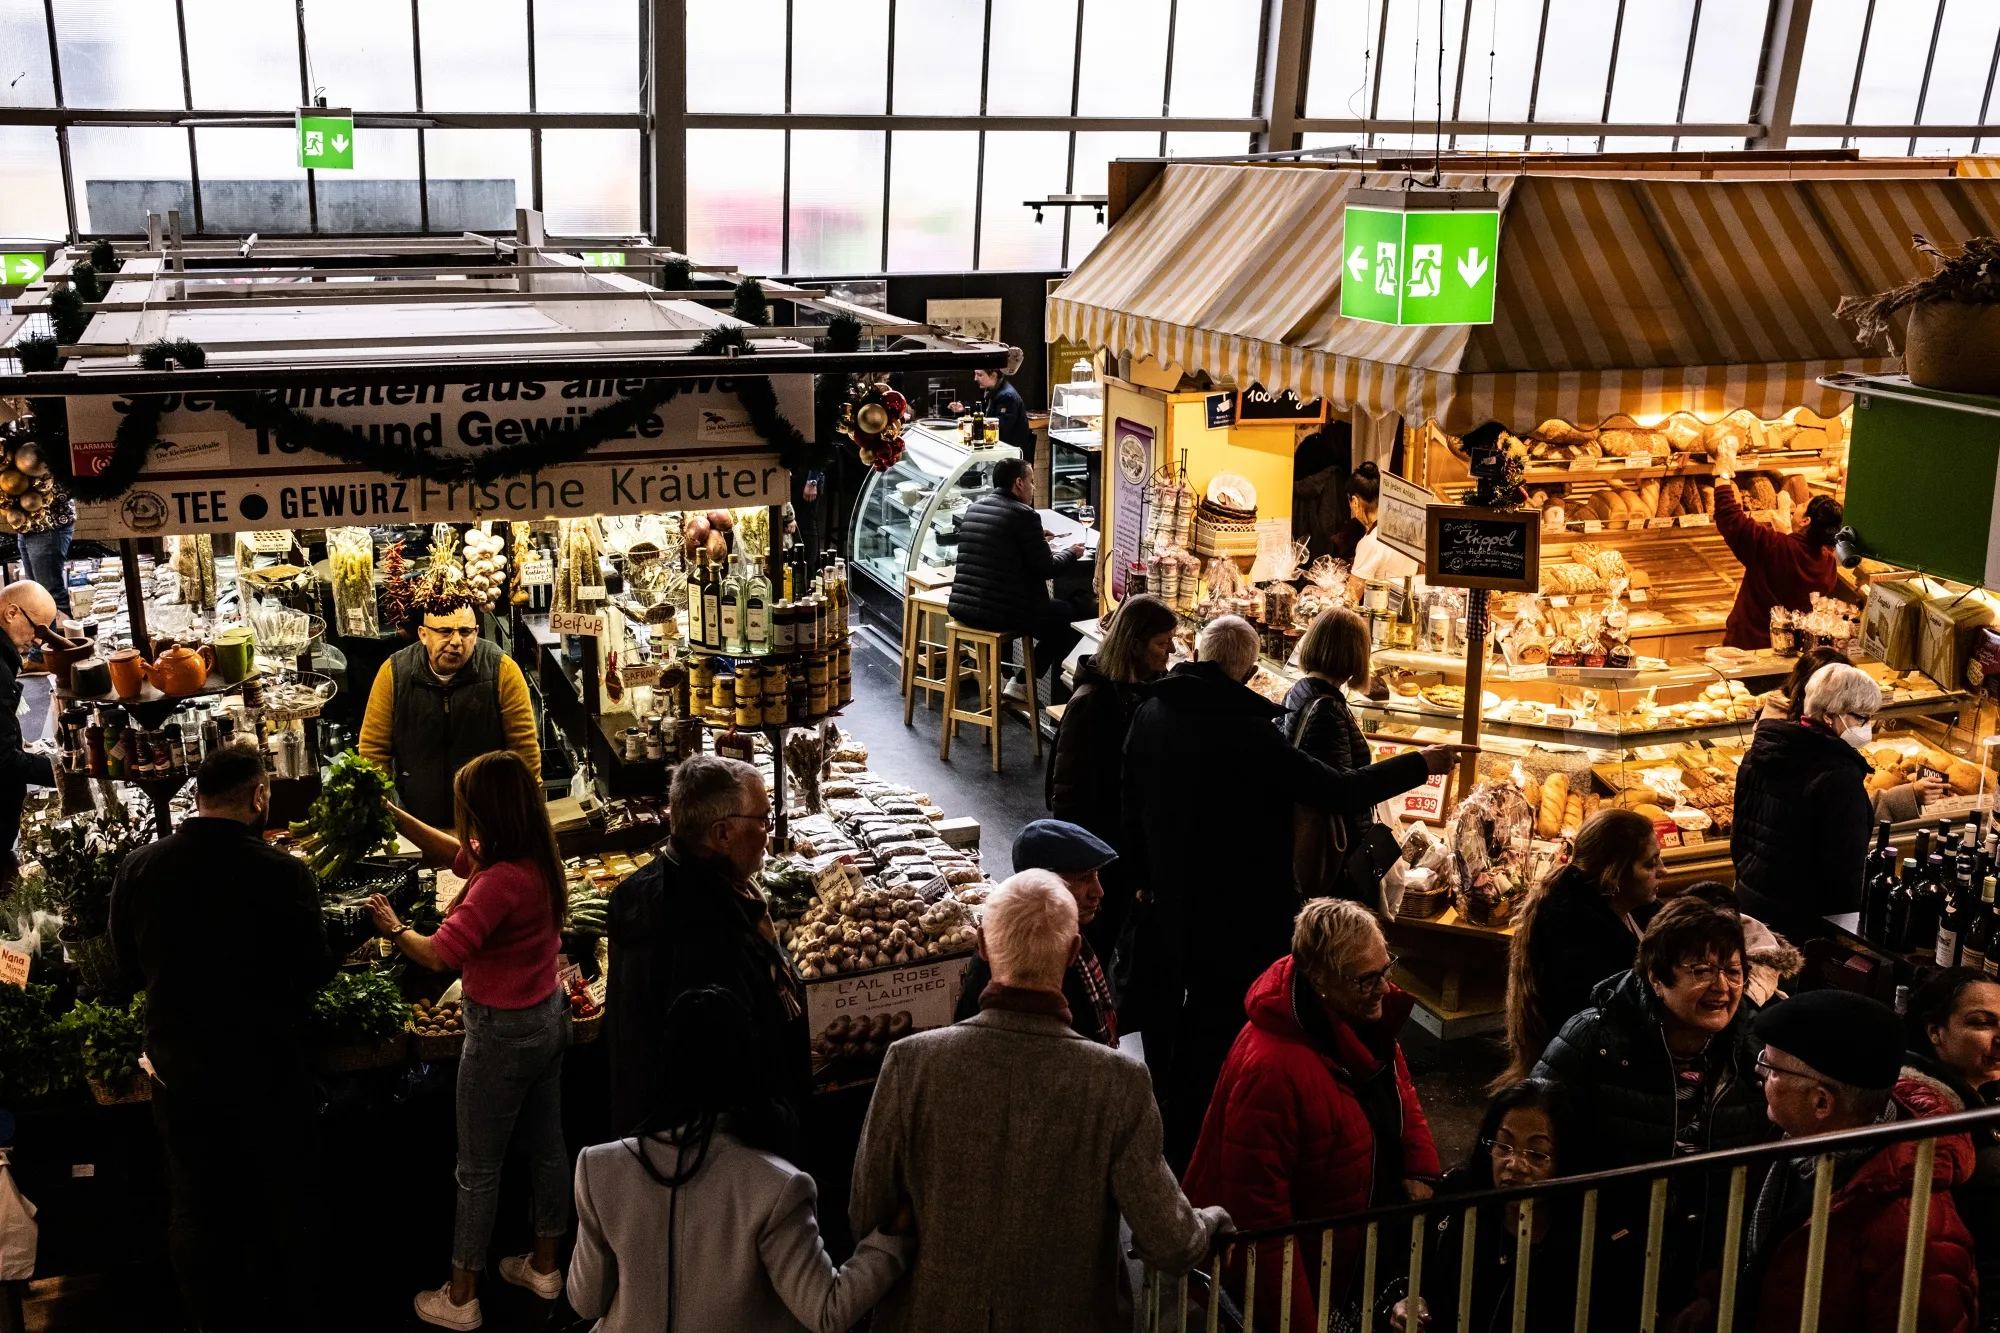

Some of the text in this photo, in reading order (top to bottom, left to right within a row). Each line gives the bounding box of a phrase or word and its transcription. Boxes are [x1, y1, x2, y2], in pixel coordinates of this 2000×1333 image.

[463, 378, 547, 401] aus
[458, 407, 664, 447] Gewüe
[169, 441, 220, 457] Kleinmarkthalle
[419, 463, 777, 511] Frische Kräuter
[171, 489, 228, 524] TEE
[280, 482, 409, 520] GEWÜRZ
[551, 613, 604, 635] Beifuß
[624, 669, 656, 682] SAFRAN
[1425, 774, 1442, 785] ,99
[1, 948, 25, 965] Nana
[5, 962, 26, 978] Minze
[893, 966, 941, 984] ROSE
[835, 978, 946, 1009] DE LAUTREC
